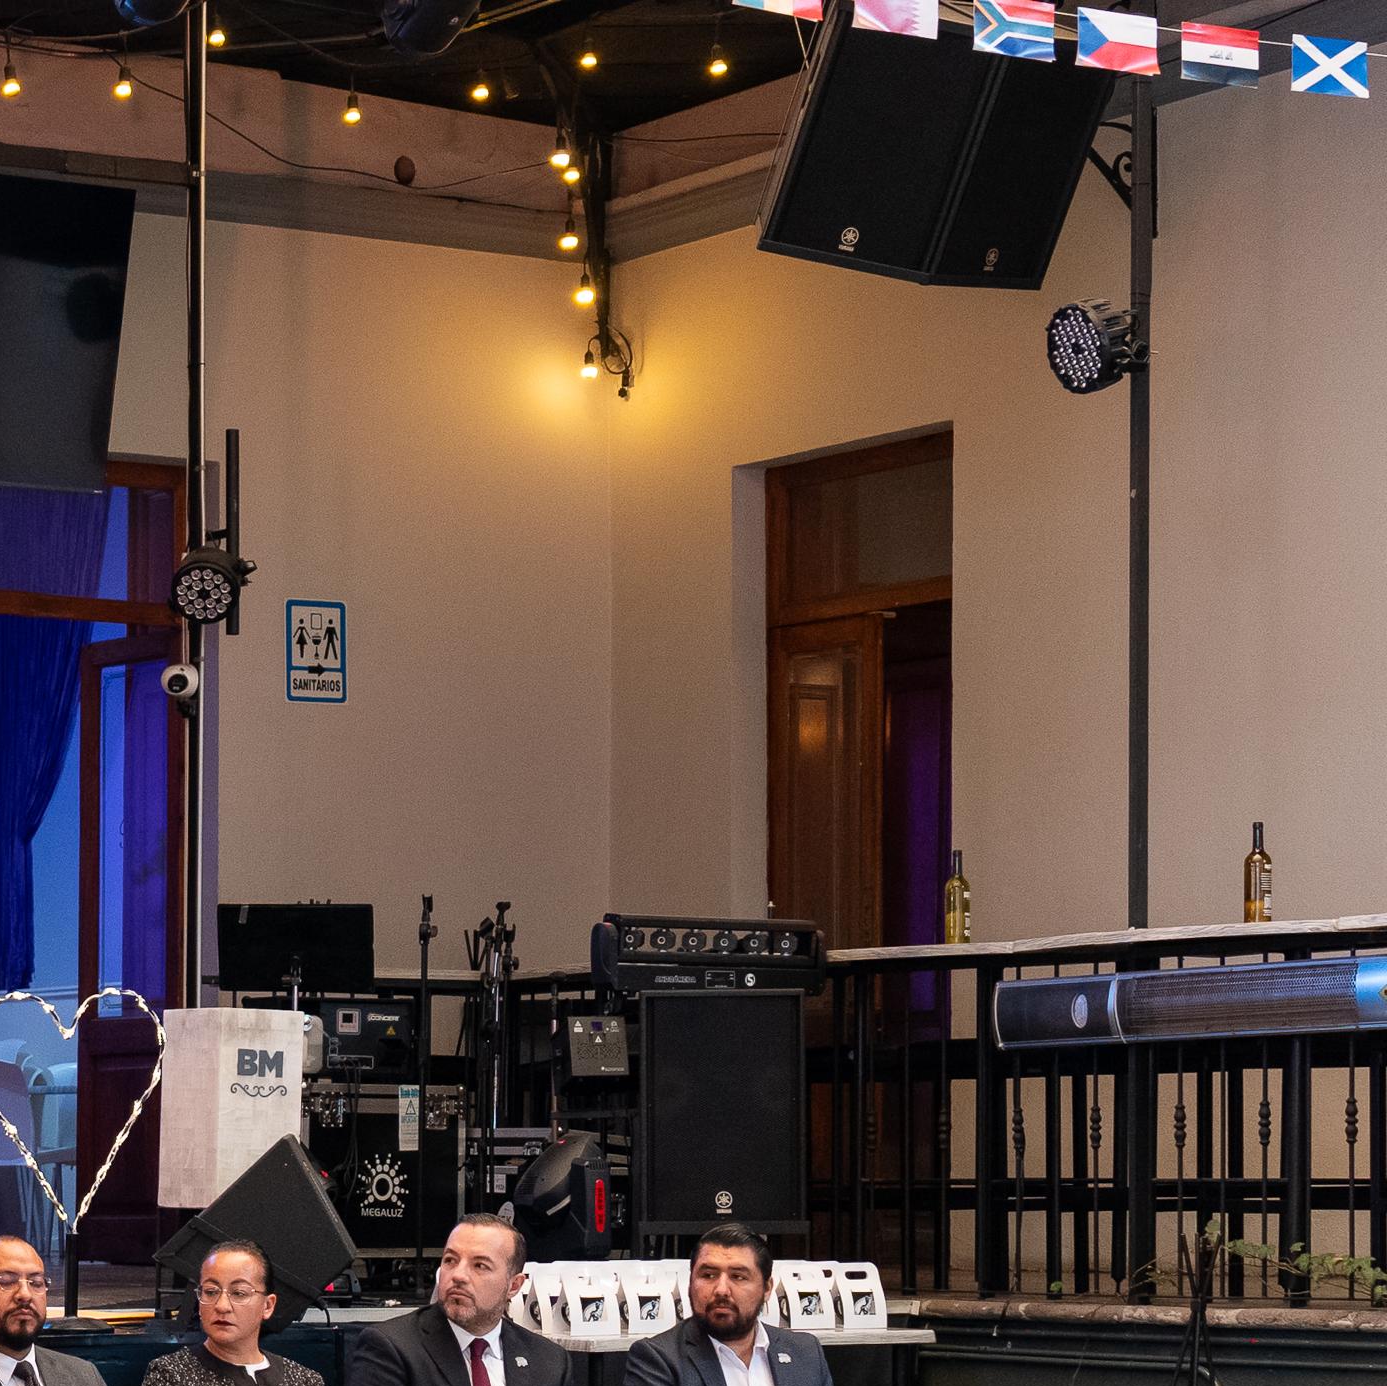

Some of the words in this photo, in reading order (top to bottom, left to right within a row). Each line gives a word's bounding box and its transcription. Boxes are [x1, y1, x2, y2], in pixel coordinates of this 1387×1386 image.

[292, 678, 342, 693] SANITARIOS
[236, 1048, 284, 1078] BM
[360, 1207, 404, 1218] MEGALUZ
